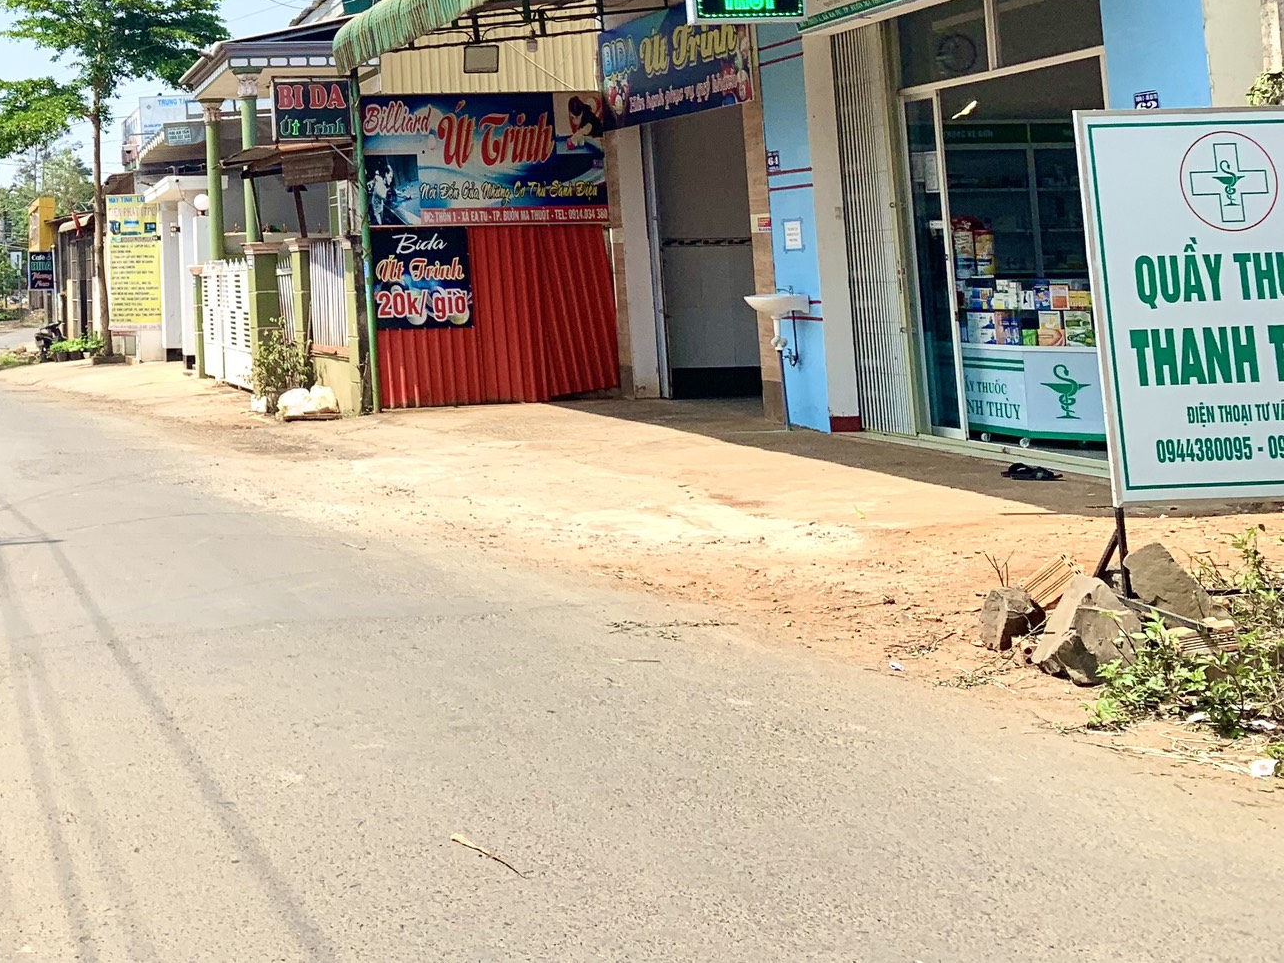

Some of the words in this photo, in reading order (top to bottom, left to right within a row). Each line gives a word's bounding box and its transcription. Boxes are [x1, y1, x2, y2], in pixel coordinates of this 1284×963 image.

[602, 34, 637, 78] BIDA
[639, 27, 669, 78] Út
[277, 85, 305, 109] BI
[308, 84, 347, 109] DA
[279, 114, 300, 136] Út
[303, 117, 346, 135] Trinh
[364, 100, 432, 135] Billiard
[437, 100, 476, 168] Út
[478, 111, 555, 167] Trinh
[420, 182, 438, 200] Nơi
[439, 181, 460, 200] Đến
[392, 233, 447, 254] Bida
[376, 255, 404, 282] Út
[1134, 237, 1222, 309] QUẦY
[377, 289, 428, 318] 20k/
[432, 288, 468, 321] giờ
[1129, 325, 1260, 386] THANH
[977, 379, 1007, 394] THUỐC
[987, 398, 1021, 420] THÙY
[1187, 402, 1215, 427] ĐIỆN
[1218, 404, 1253, 426] THOẠI
[1255, 402, 1270, 421] TƯ
[1156, 437, 1253, 462] 0944380095
